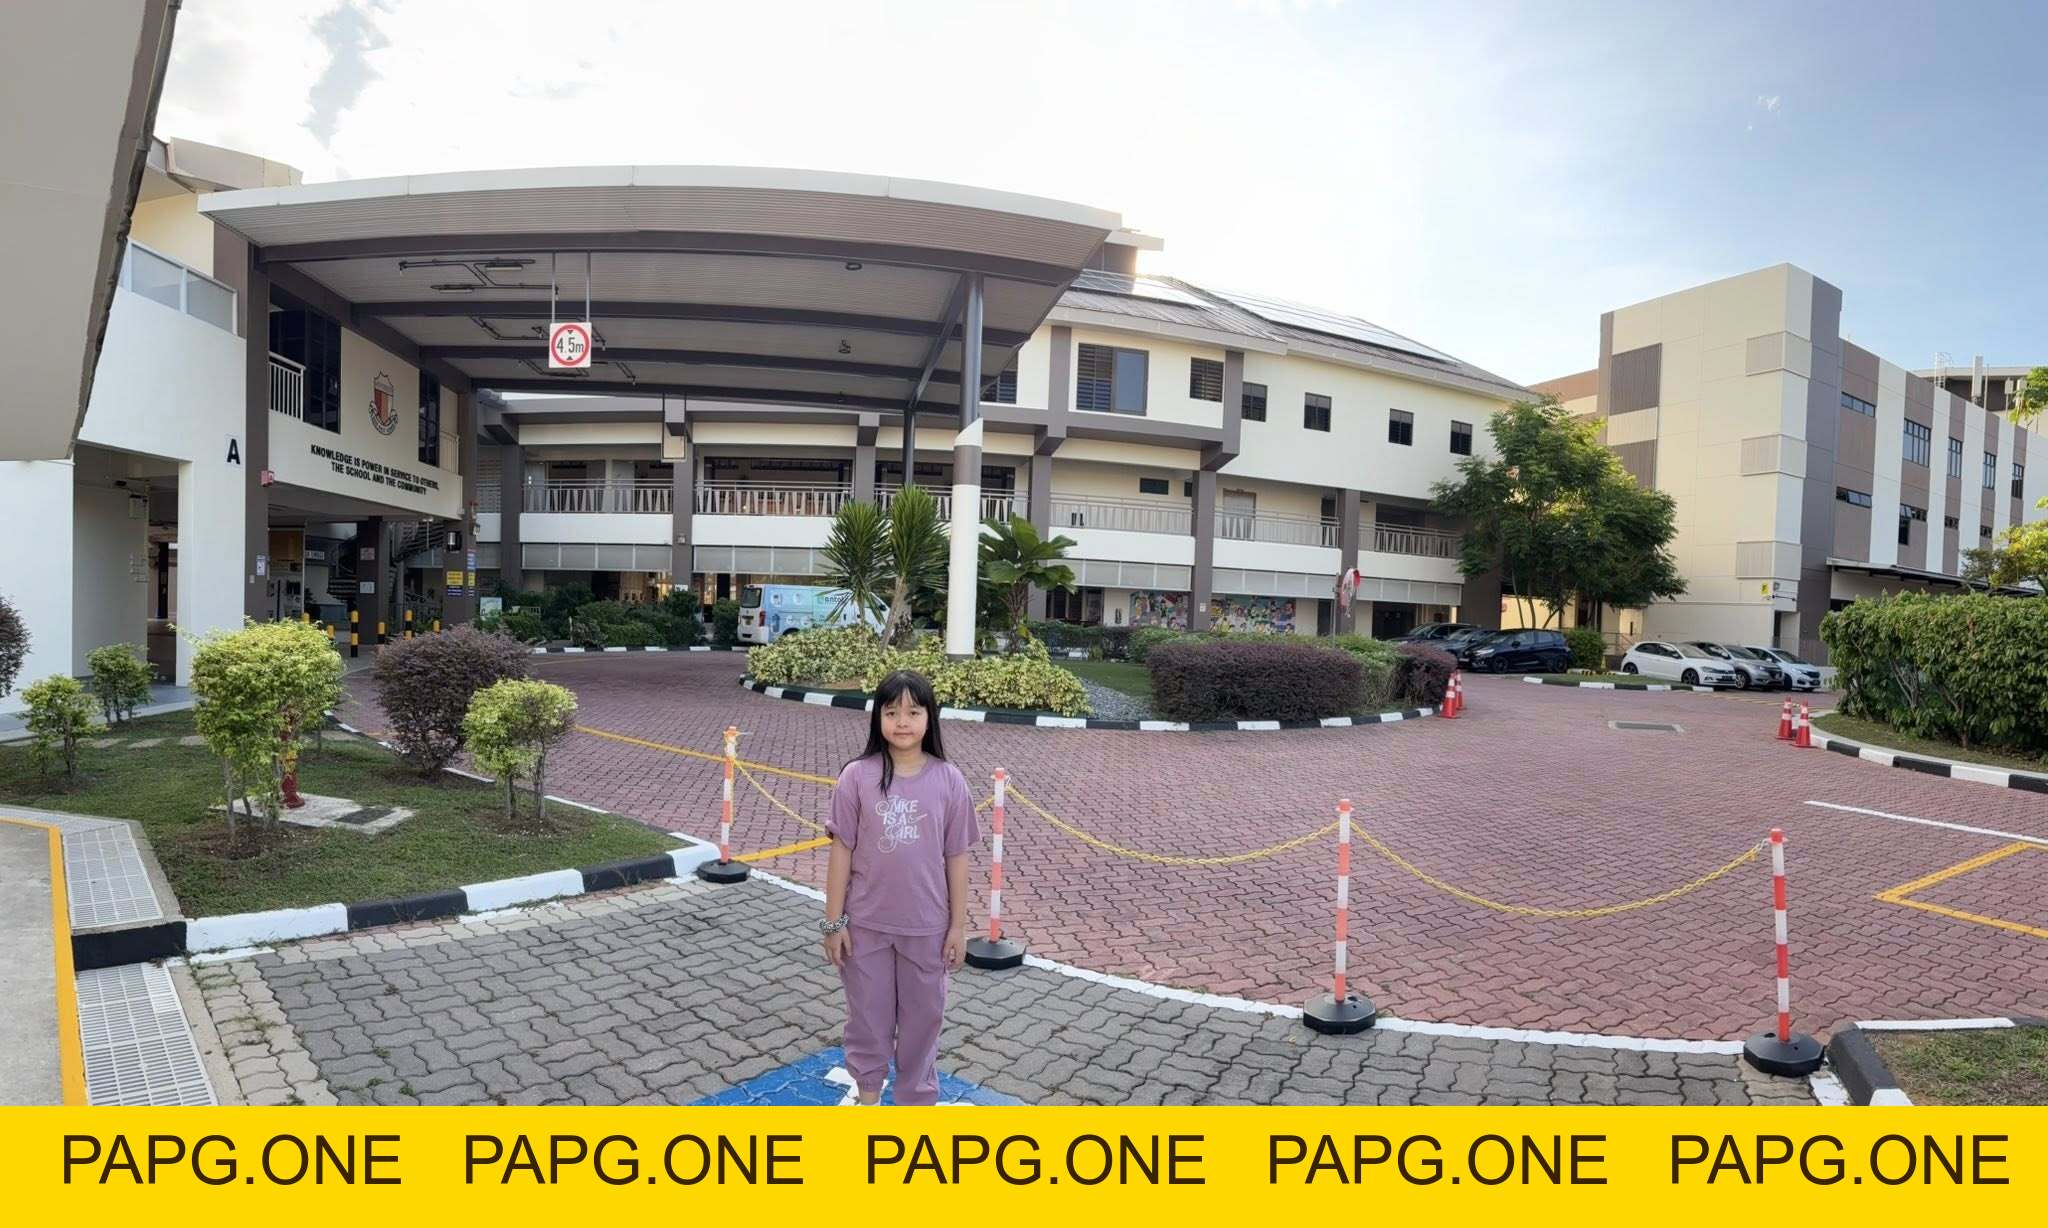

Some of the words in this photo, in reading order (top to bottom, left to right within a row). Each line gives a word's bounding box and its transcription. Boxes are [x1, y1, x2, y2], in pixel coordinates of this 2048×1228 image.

[556, 336, 584, 353] 4.5m
[226, 438, 241, 465] A
[310, 443, 353, 465] KNOWLEDGE
[353, 457, 361, 467] IS
[361, 459, 383, 473] POWER
[383, 466, 390, 476] IN
[390, 468, 412, 481] SERVICE
[412, 474, 420, 484] TO
[331, 461, 345, 474] THE
[345, 466, 371, 481] SCHOOL
[372, 473, 385, 484] AND
[385, 476, 397, 488] THE
[882, 812, 897, 825] IS
